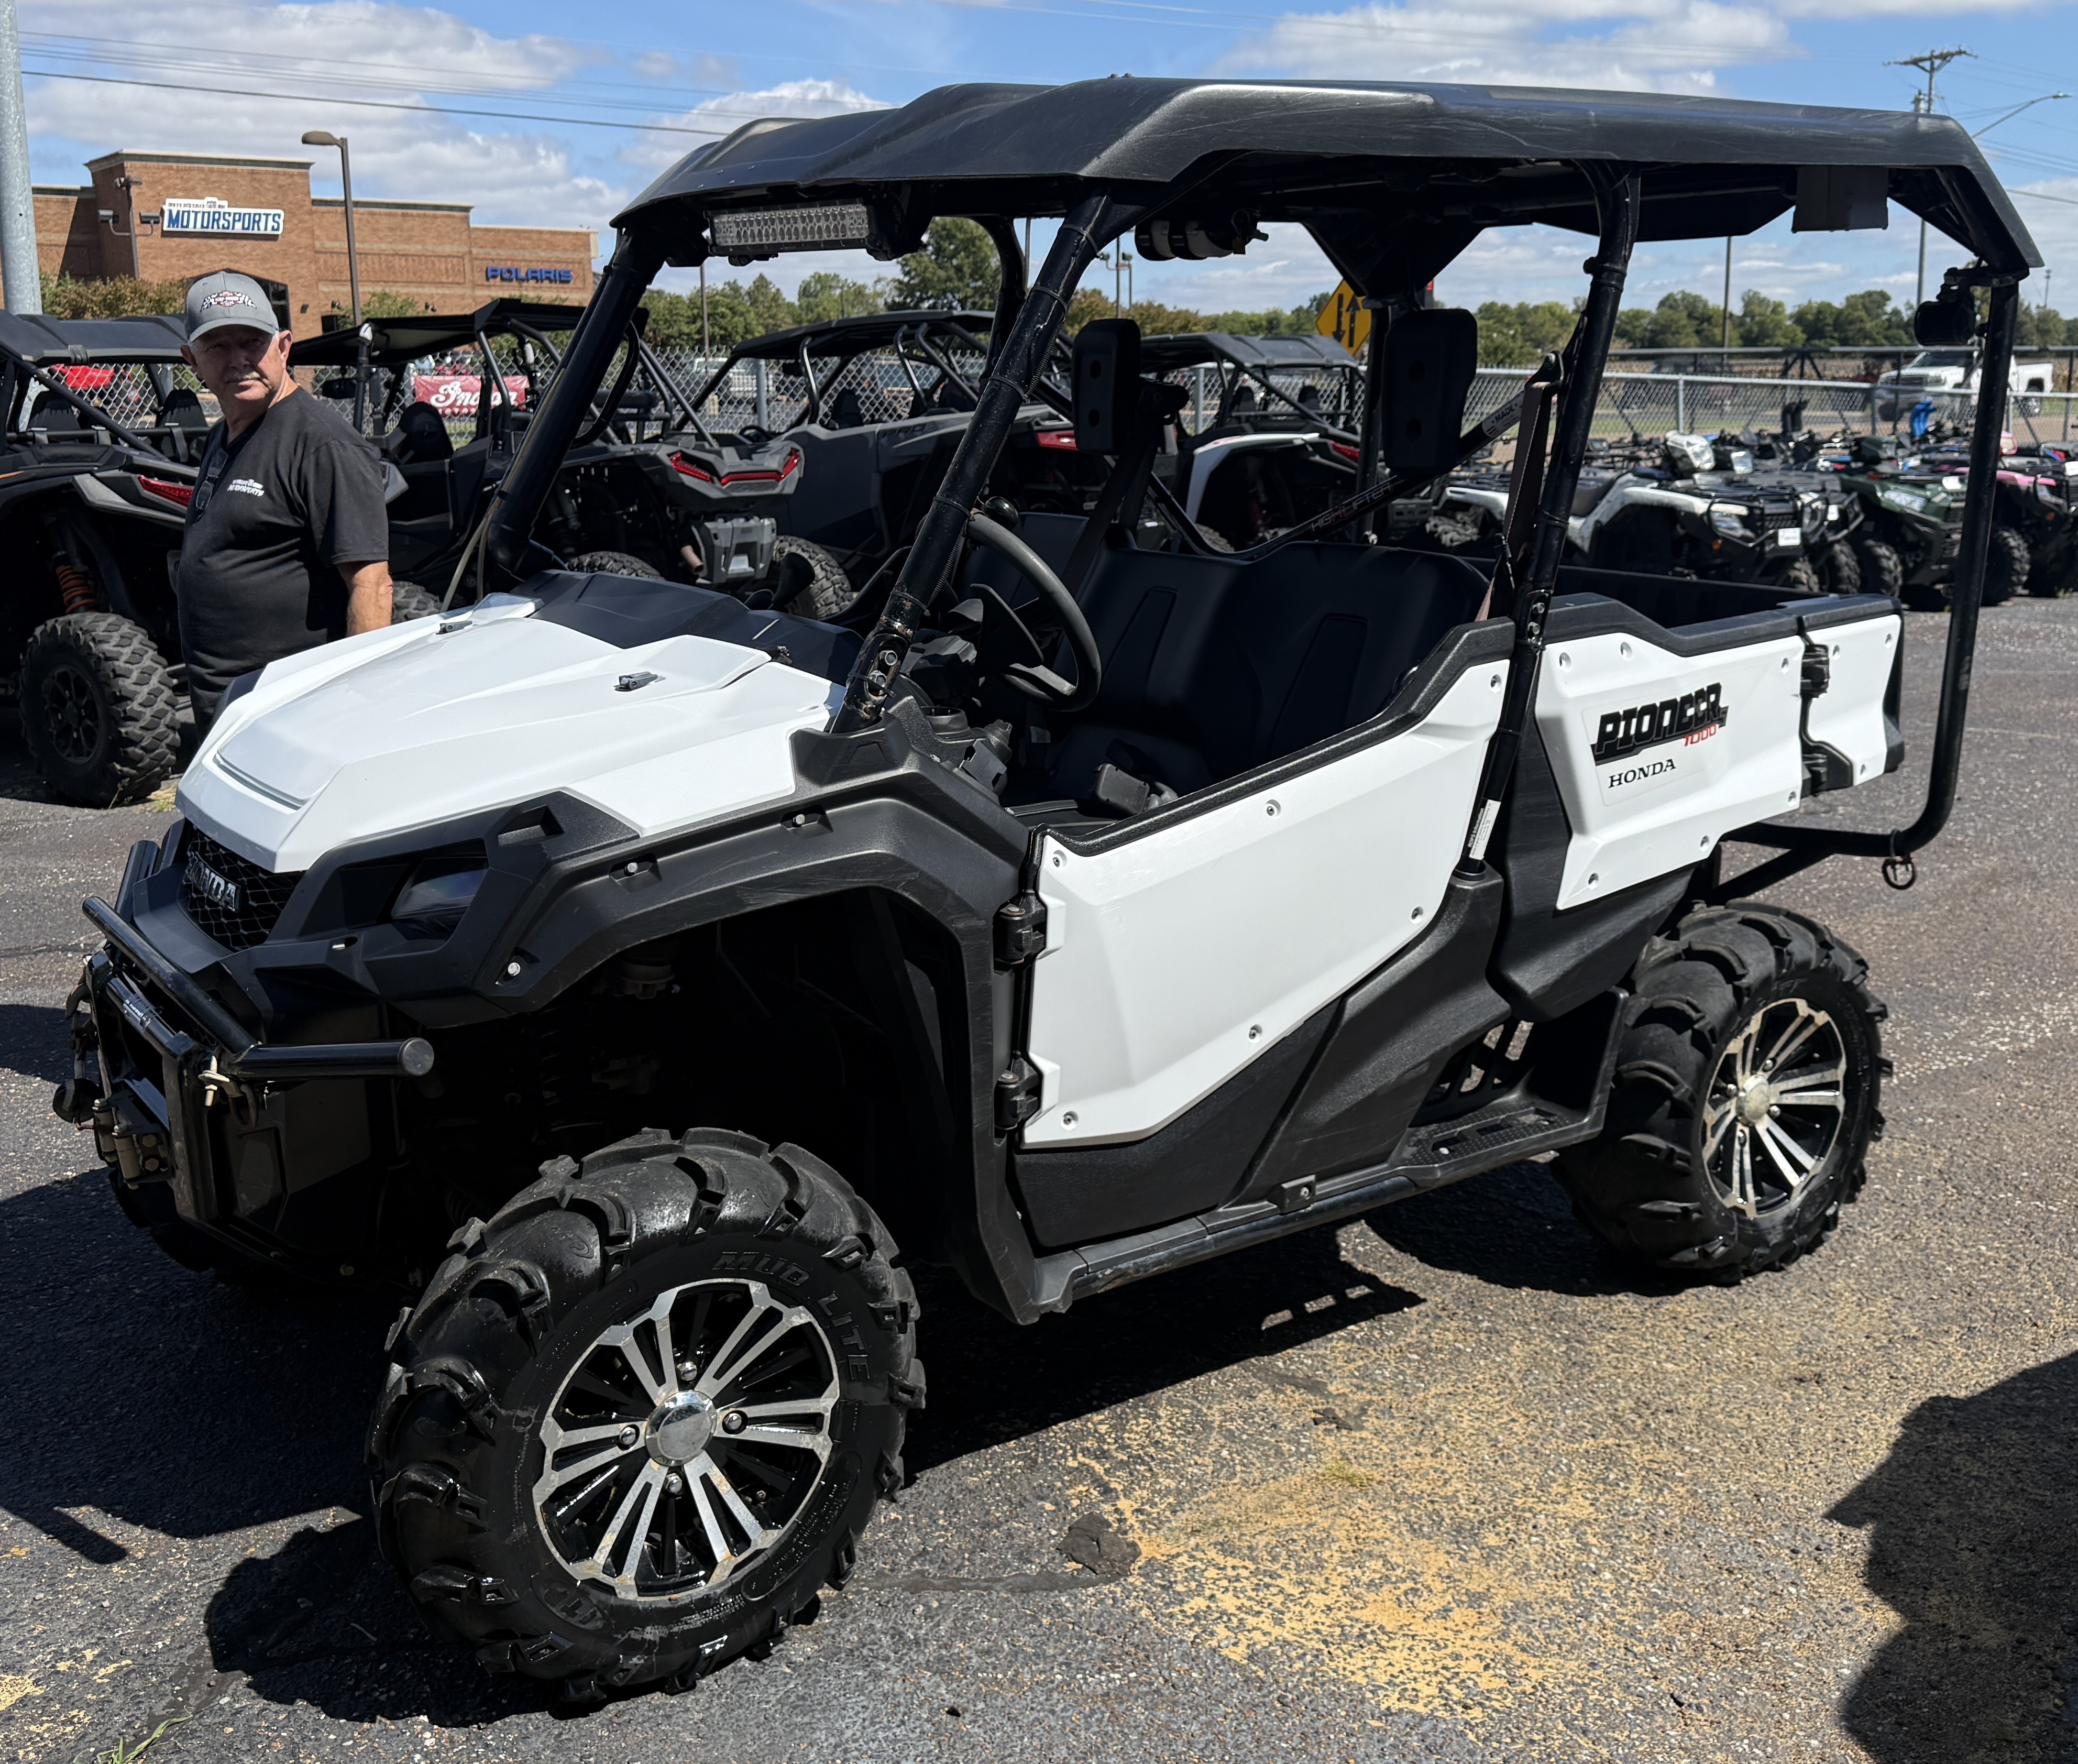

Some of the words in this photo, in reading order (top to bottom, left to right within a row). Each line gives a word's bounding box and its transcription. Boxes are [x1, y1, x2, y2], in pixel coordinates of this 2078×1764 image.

[167, 209, 281, 231] MOTORSPORTS
[486, 266, 573, 283] POLARIS
[1596, 682, 1722, 754] PIONEER
[1684, 723, 1719, 747] 1000
[1608, 759, 1676, 788] HONDA
[711, 1251, 810, 1285] MUD
[817, 1290, 871, 1380] LITE
